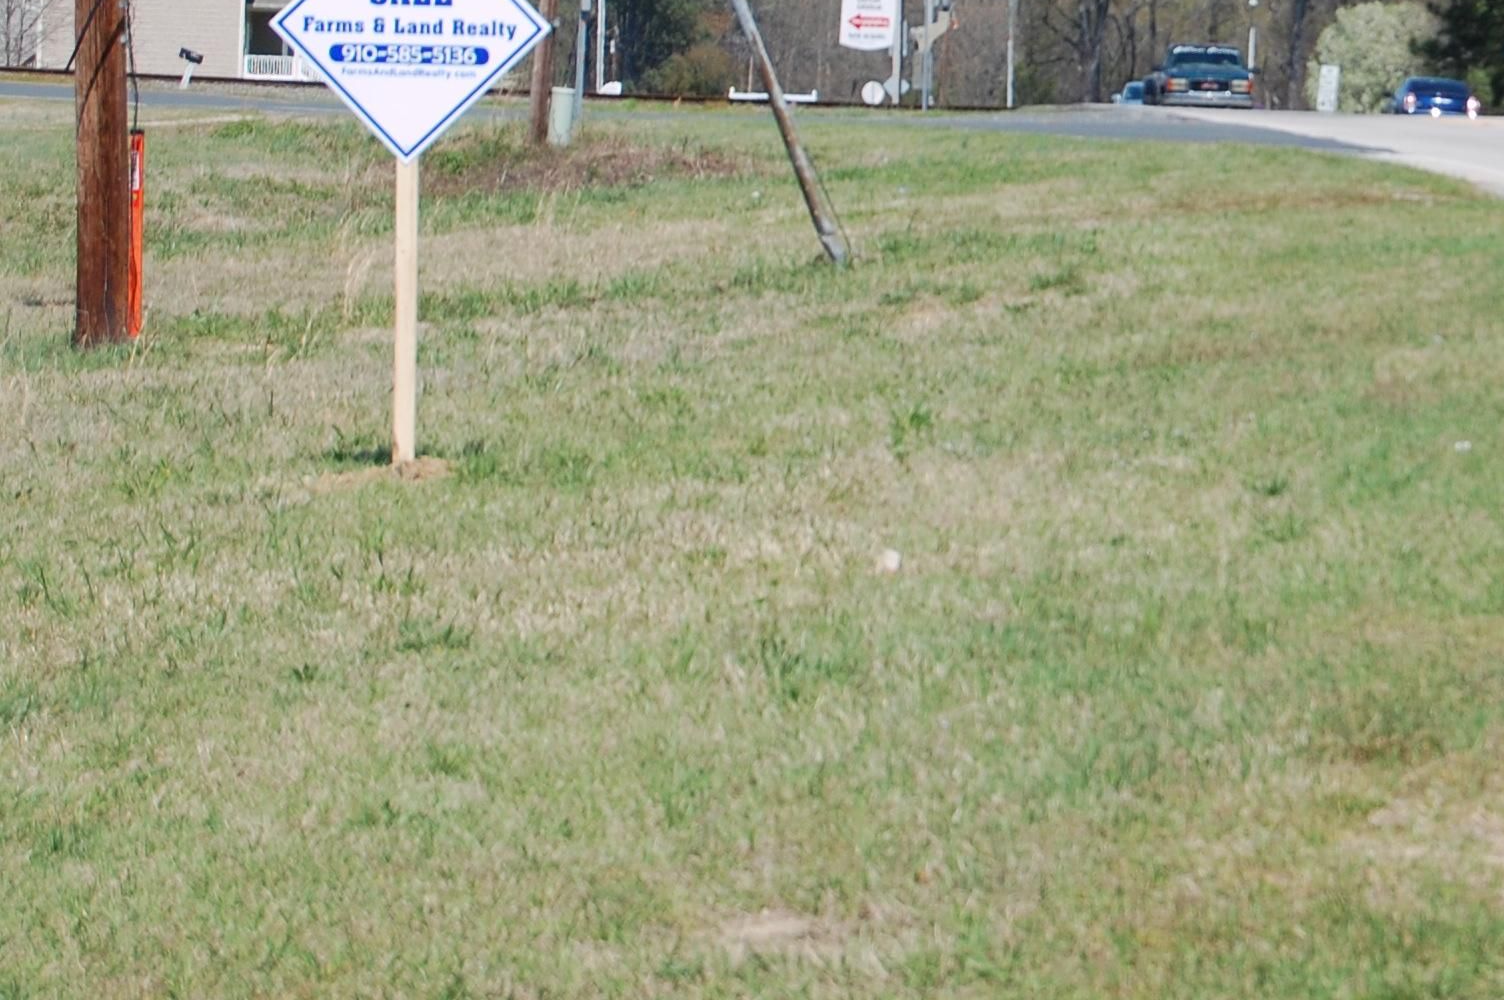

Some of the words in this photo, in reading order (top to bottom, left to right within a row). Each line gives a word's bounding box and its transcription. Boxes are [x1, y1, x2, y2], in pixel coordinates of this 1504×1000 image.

[303, 16, 364, 34] Farms
[373, 17, 385, 34] &
[395, 18, 444, 36] Land
[453, 20, 517, 42] Realty
[341, 44, 477, 65] 910-585-5136
